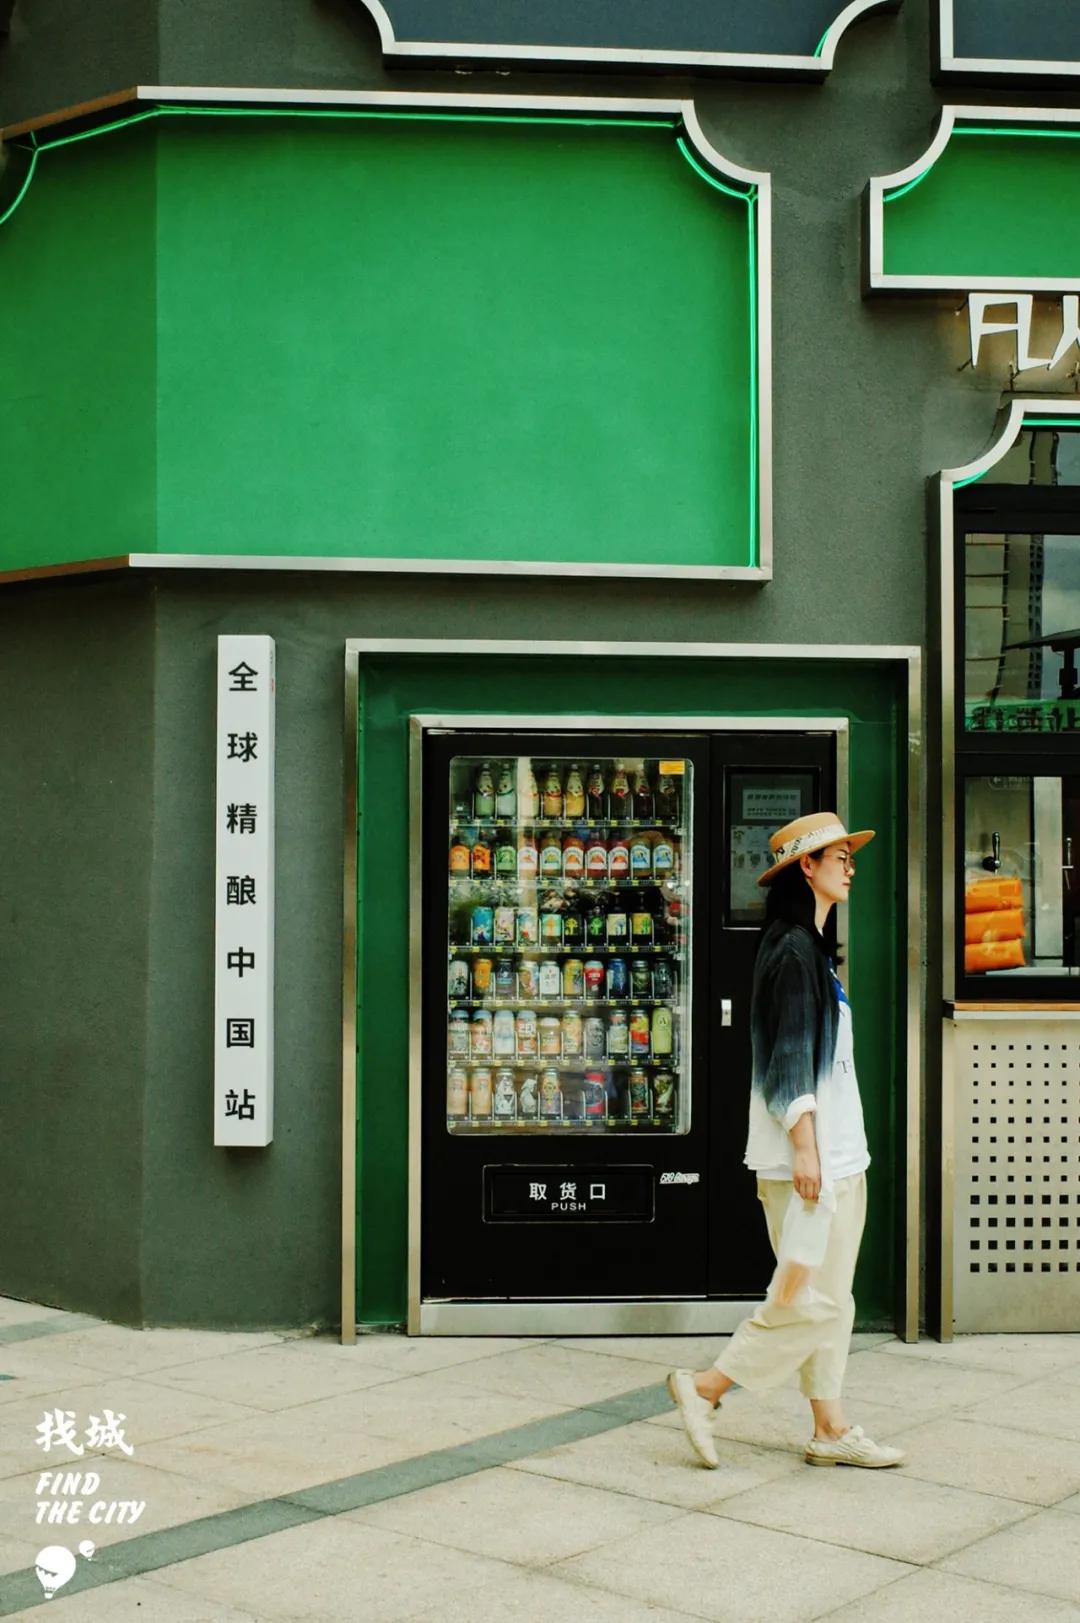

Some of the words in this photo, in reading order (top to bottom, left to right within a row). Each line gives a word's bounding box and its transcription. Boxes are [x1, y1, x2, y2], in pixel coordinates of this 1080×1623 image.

[225, 661, 259, 1121] 全球精酿中国站
[529, 1183, 605, 1200] 取货口
[551, 1202, 586, 1211] PUSH
